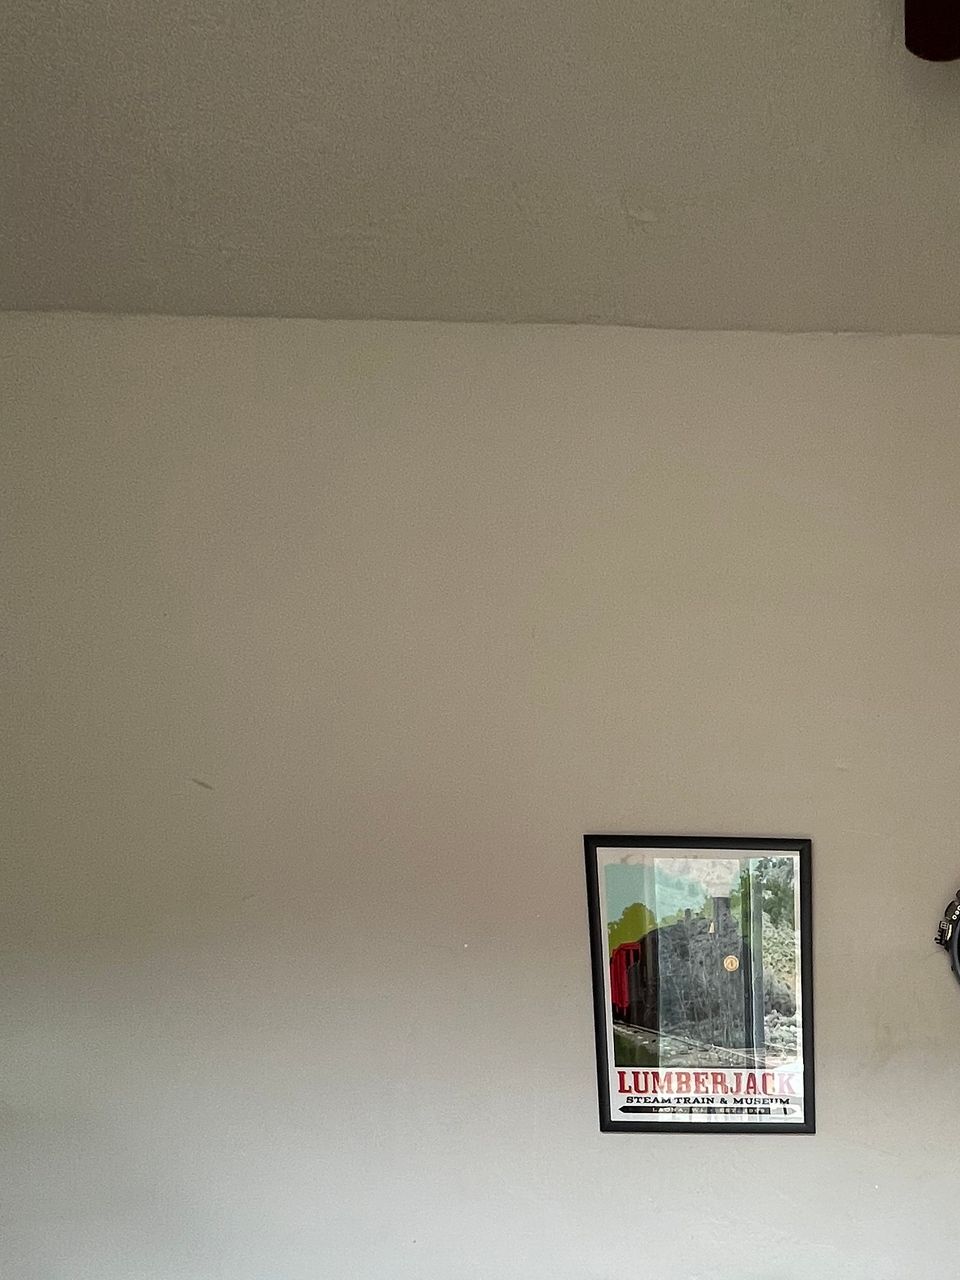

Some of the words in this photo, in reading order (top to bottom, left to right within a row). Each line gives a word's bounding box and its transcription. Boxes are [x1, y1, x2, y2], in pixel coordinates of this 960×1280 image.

[617, 1071, 796, 1095] LUMBERJACK
[626, 1096, 671, 1104] STEAM
[674, 1096, 714, 1105] TRAIN
[719, 1097, 728, 1105] &
[733, 1097, 790, 1105] MUSEUM
